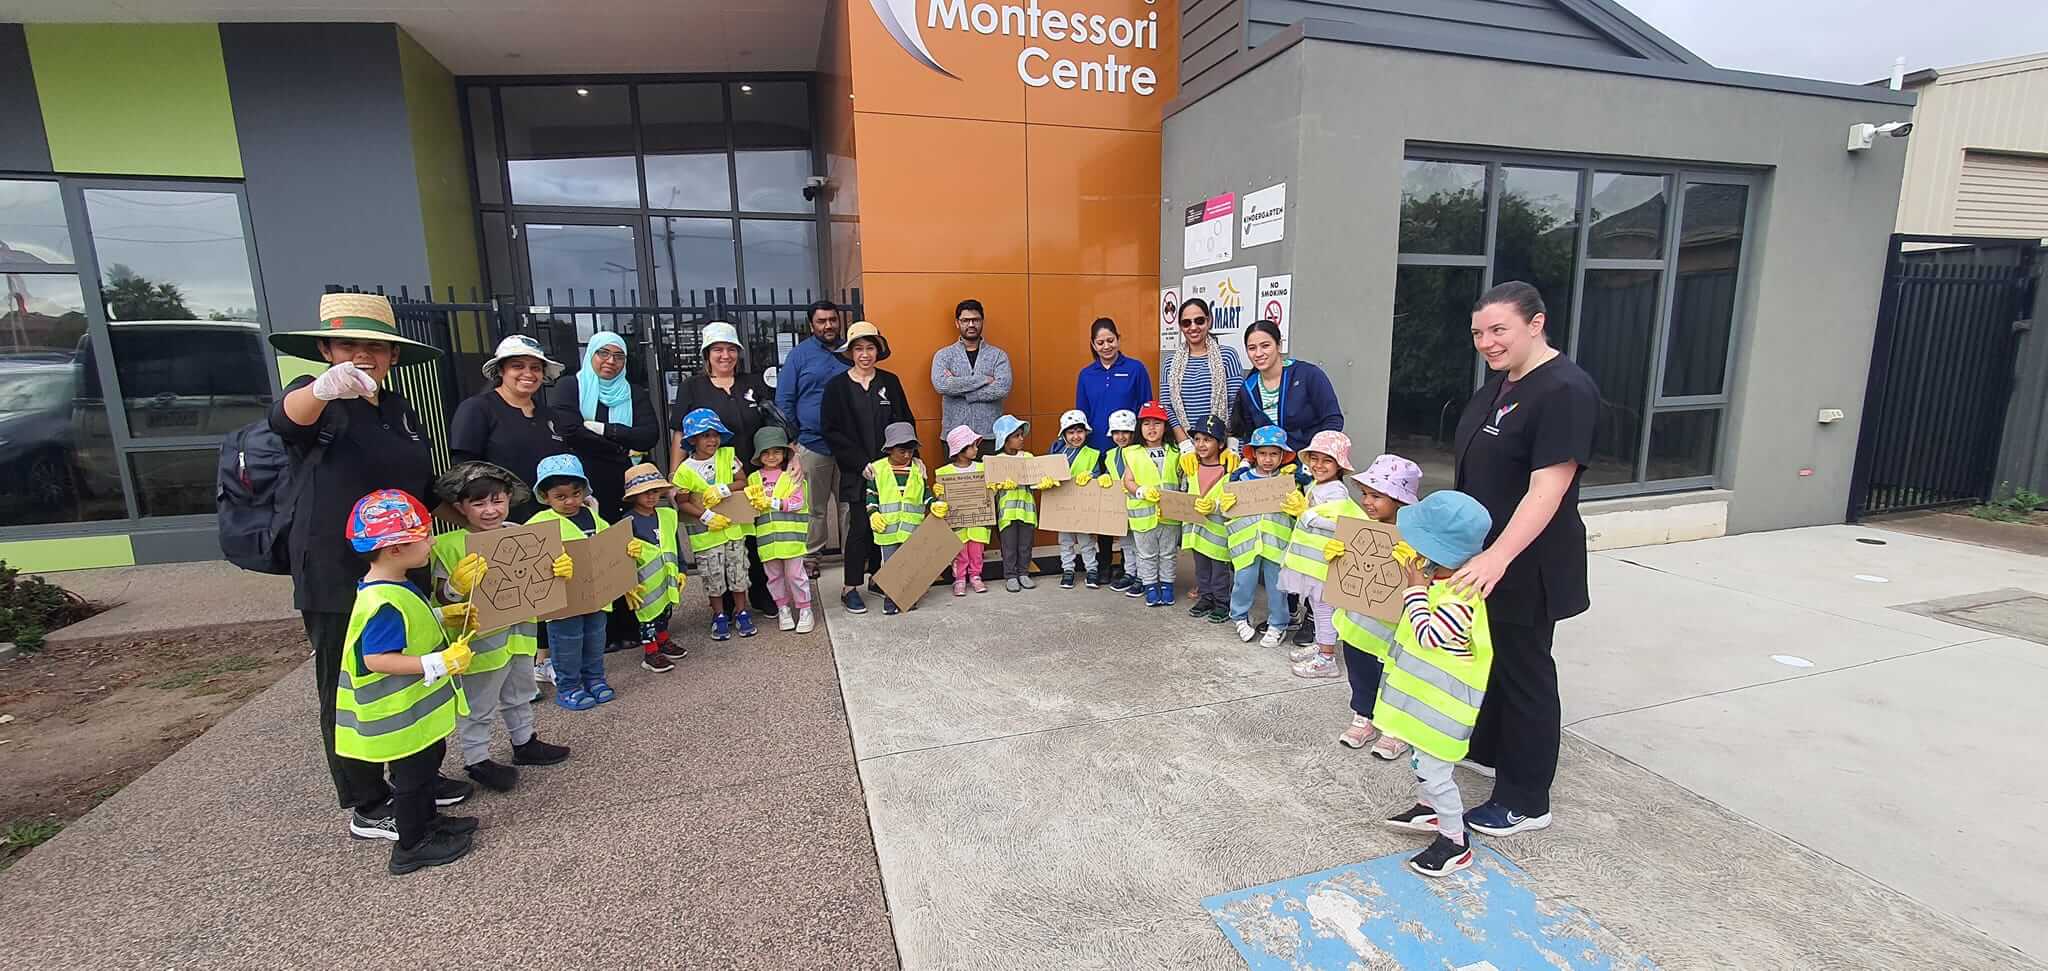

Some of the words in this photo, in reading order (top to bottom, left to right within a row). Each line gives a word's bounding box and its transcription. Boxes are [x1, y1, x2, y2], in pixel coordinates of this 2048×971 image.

[927, 0, 1158, 50] Montessori
[1016, 47, 1157, 96] Centre
[1243, 207, 1283, 223] KINDERGARTEN
[1261, 288, 1288, 298] SMOKING
[1270, 281, 1279, 289] NO
